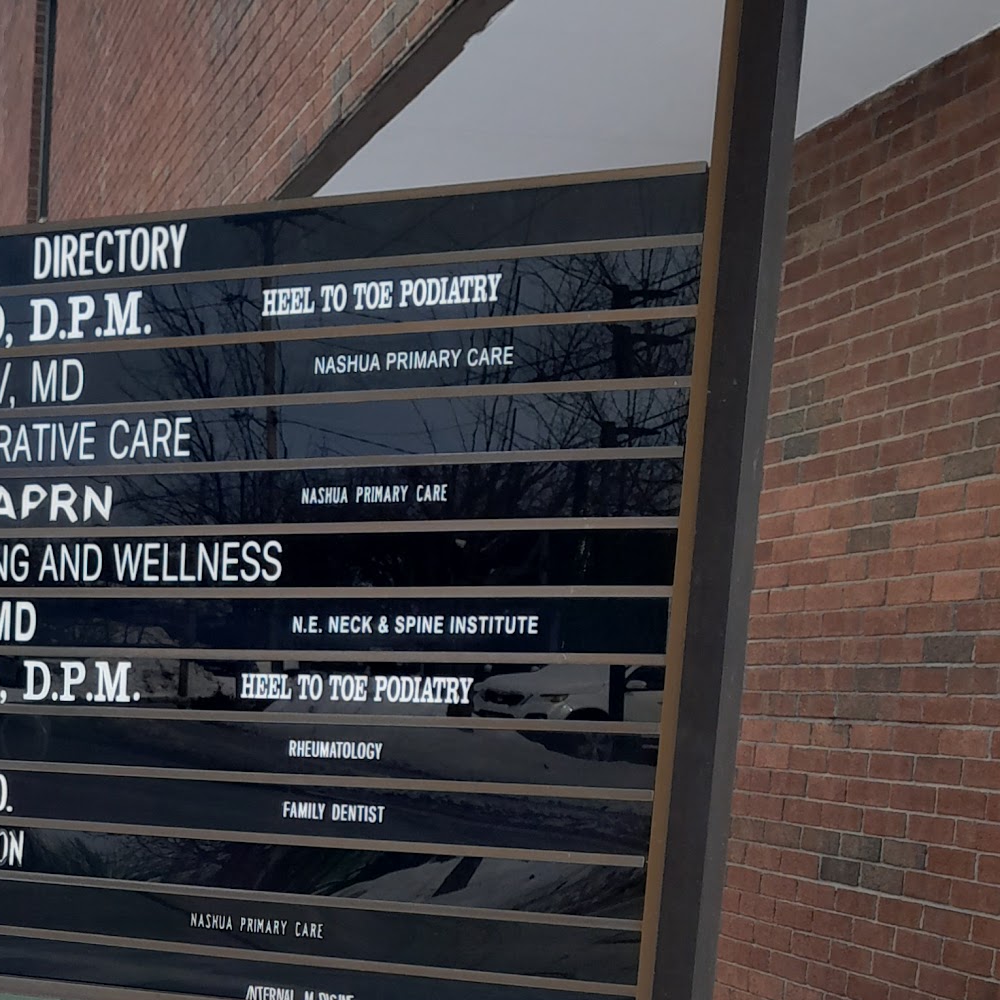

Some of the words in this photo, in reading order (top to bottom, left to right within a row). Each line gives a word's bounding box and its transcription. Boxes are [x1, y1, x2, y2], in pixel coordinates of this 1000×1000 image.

[33, 223, 188, 280] DIRECTORY
[261, 286, 316, 317] HEEL
[320, 283, 348, 313] TO
[353, 280, 394, 311] TOE
[398, 273, 503, 308] PODIATRY
[29, 290, 152, 342] D.P.M.
[314, 353, 381, 375] NASHUA
[386, 348, 462, 371] PRIMARY
[467, 345, 514, 367] CARE
[31, 358, 84, 403] MD
[109, 416, 192, 460] CARE
[301, 486, 348, 505] NASHUA
[355, 485, 409, 503] PRIMARY
[416, 483, 448, 503] CARE
[38, 543, 103, 582] AND
[113, 540, 283, 582] WELLNESS
[292, 615, 323, 634] N.E.
[328, 615, 373, 634] NECK
[377, 615, 389, 634] &
[394, 615, 445, 634] SPINE
[449, 615, 539, 635] INSTITUTE
[22, 660, 141, 703] D.P.M.
[240, 673, 293, 700] HEEL
[297, 673, 324, 701] TO
[328, 674, 369, 702] TOE
[373, 675, 475, 705] PODIATRY
[288, 739, 383, 760] RHEUMATOLOGY
[282, 800, 326, 820] FAMILY
[331, 803, 386, 823] DENTIST
[190, 913, 233, 931] NASHUA
[240, 917, 288, 935] PRIMARY
[295, 921, 323, 939] CARE
